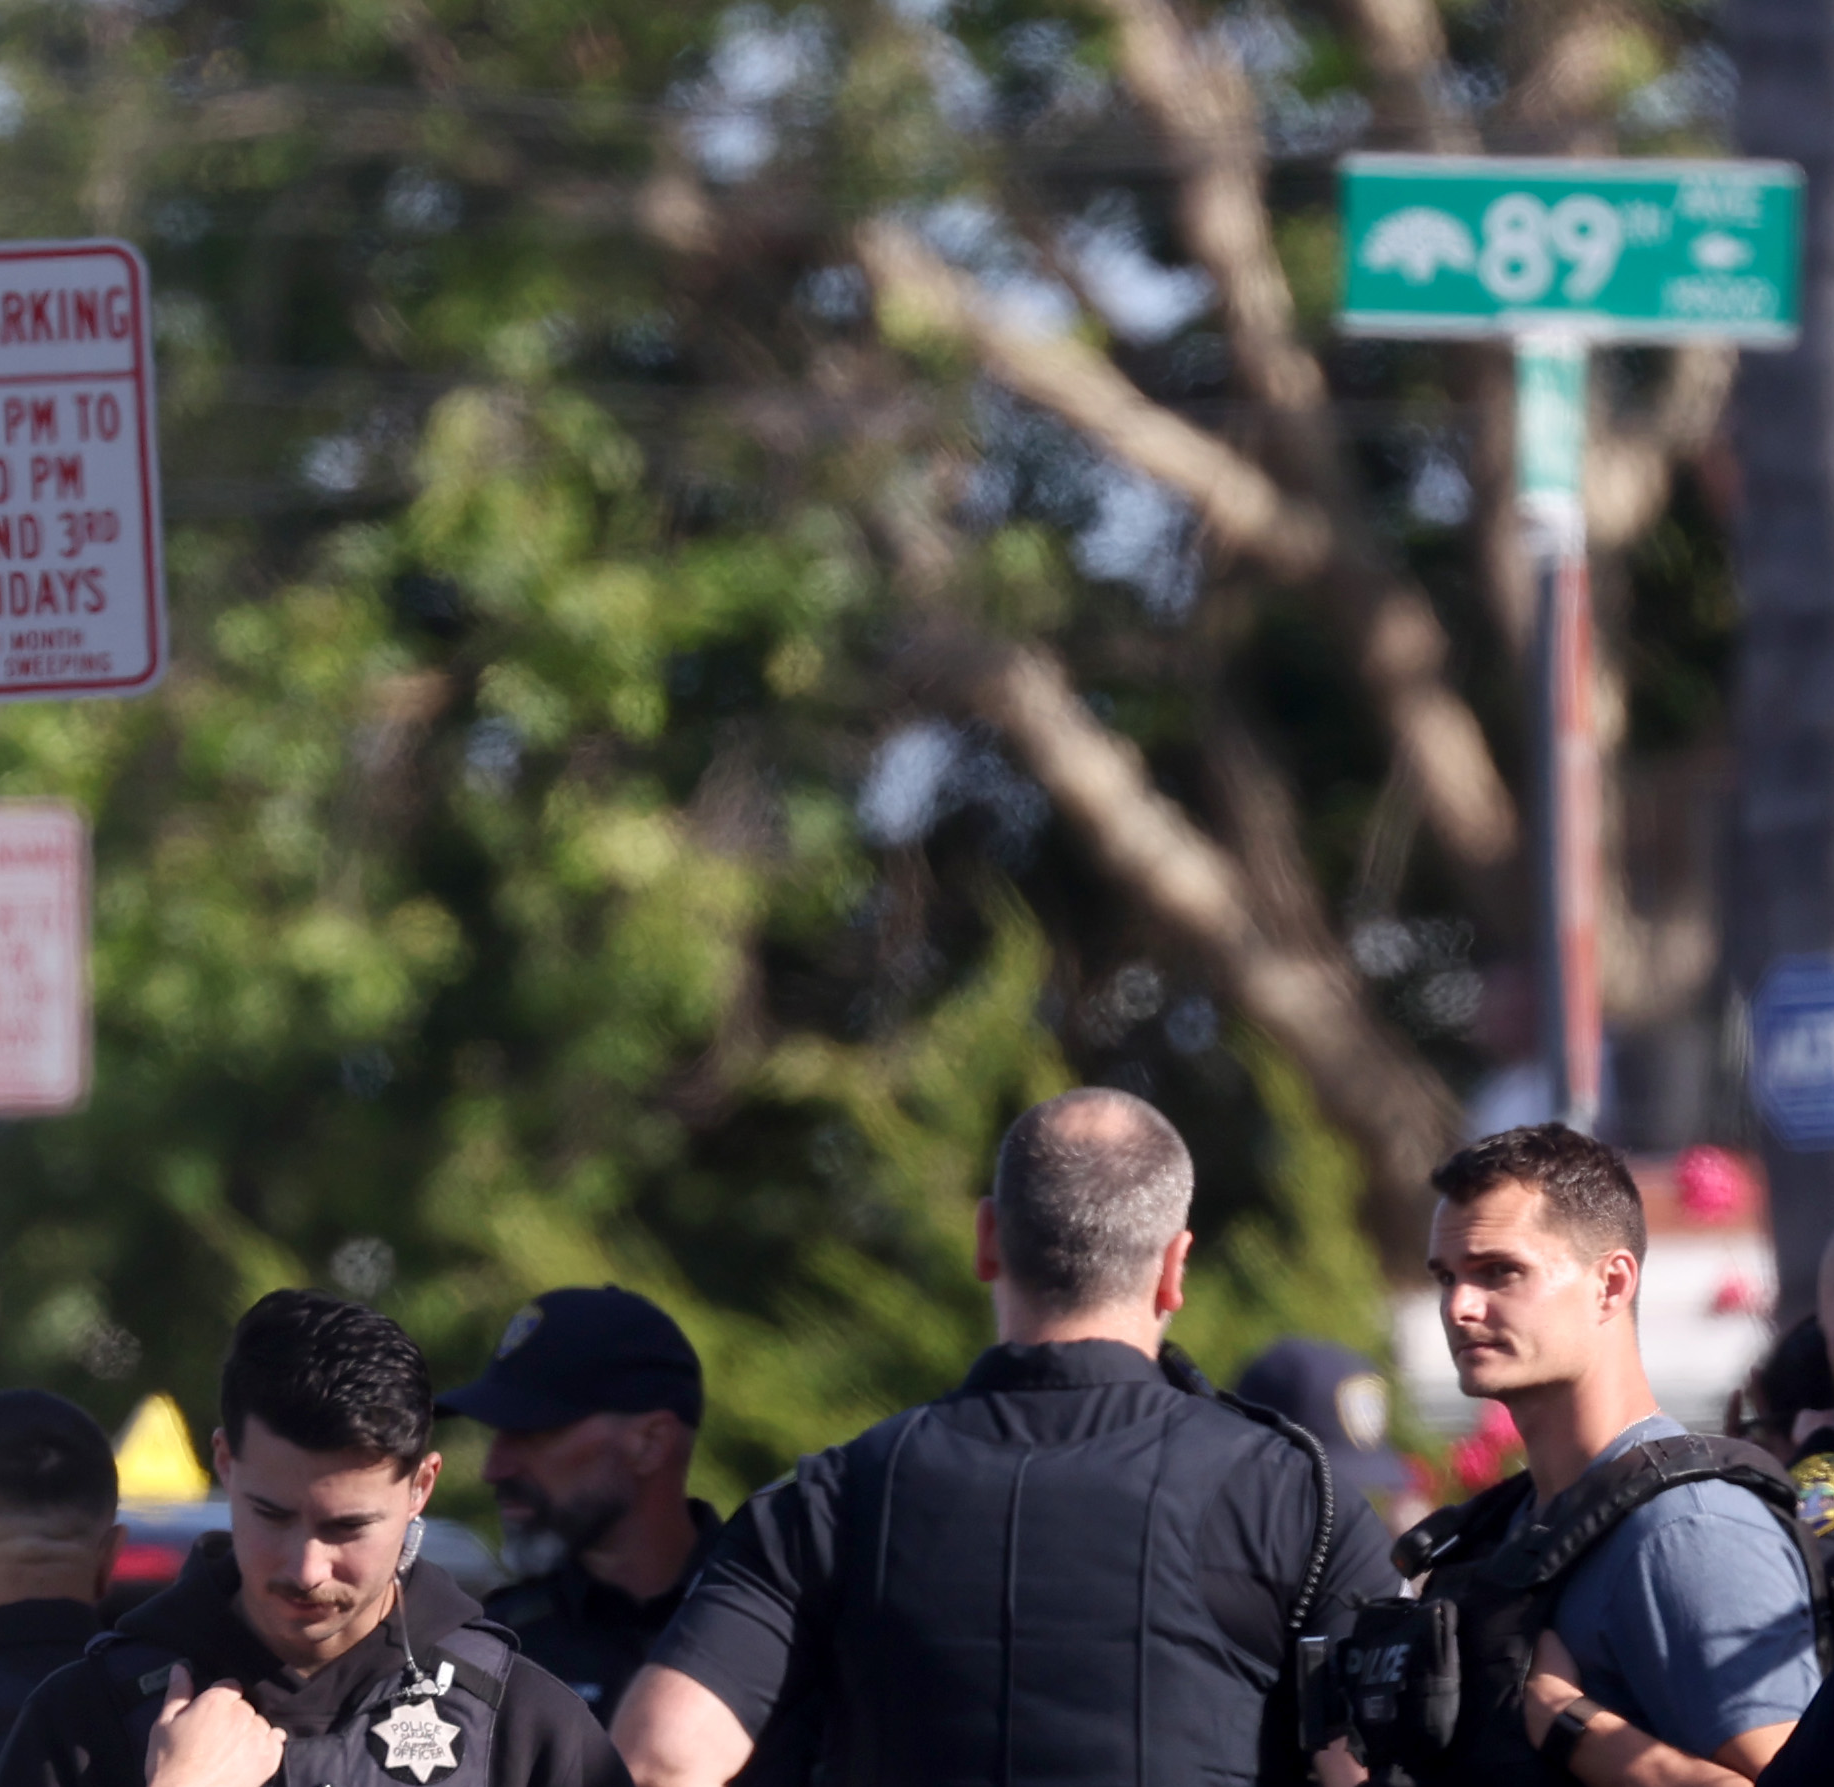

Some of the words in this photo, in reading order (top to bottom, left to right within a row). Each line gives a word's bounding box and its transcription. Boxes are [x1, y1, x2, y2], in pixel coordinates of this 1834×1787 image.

[5, 398, 58, 446] PM
[76, 393, 120, 443] TO
[31, 454, 85, 501] PM
[59, 509, 119, 558] 3RD
[10, 628, 85, 650] MONTH
[4, 652, 111, 677] SWEEPING
[391, 1721, 442, 1735] POLICE
[393, 1747, 445, 1760] OFFICER
